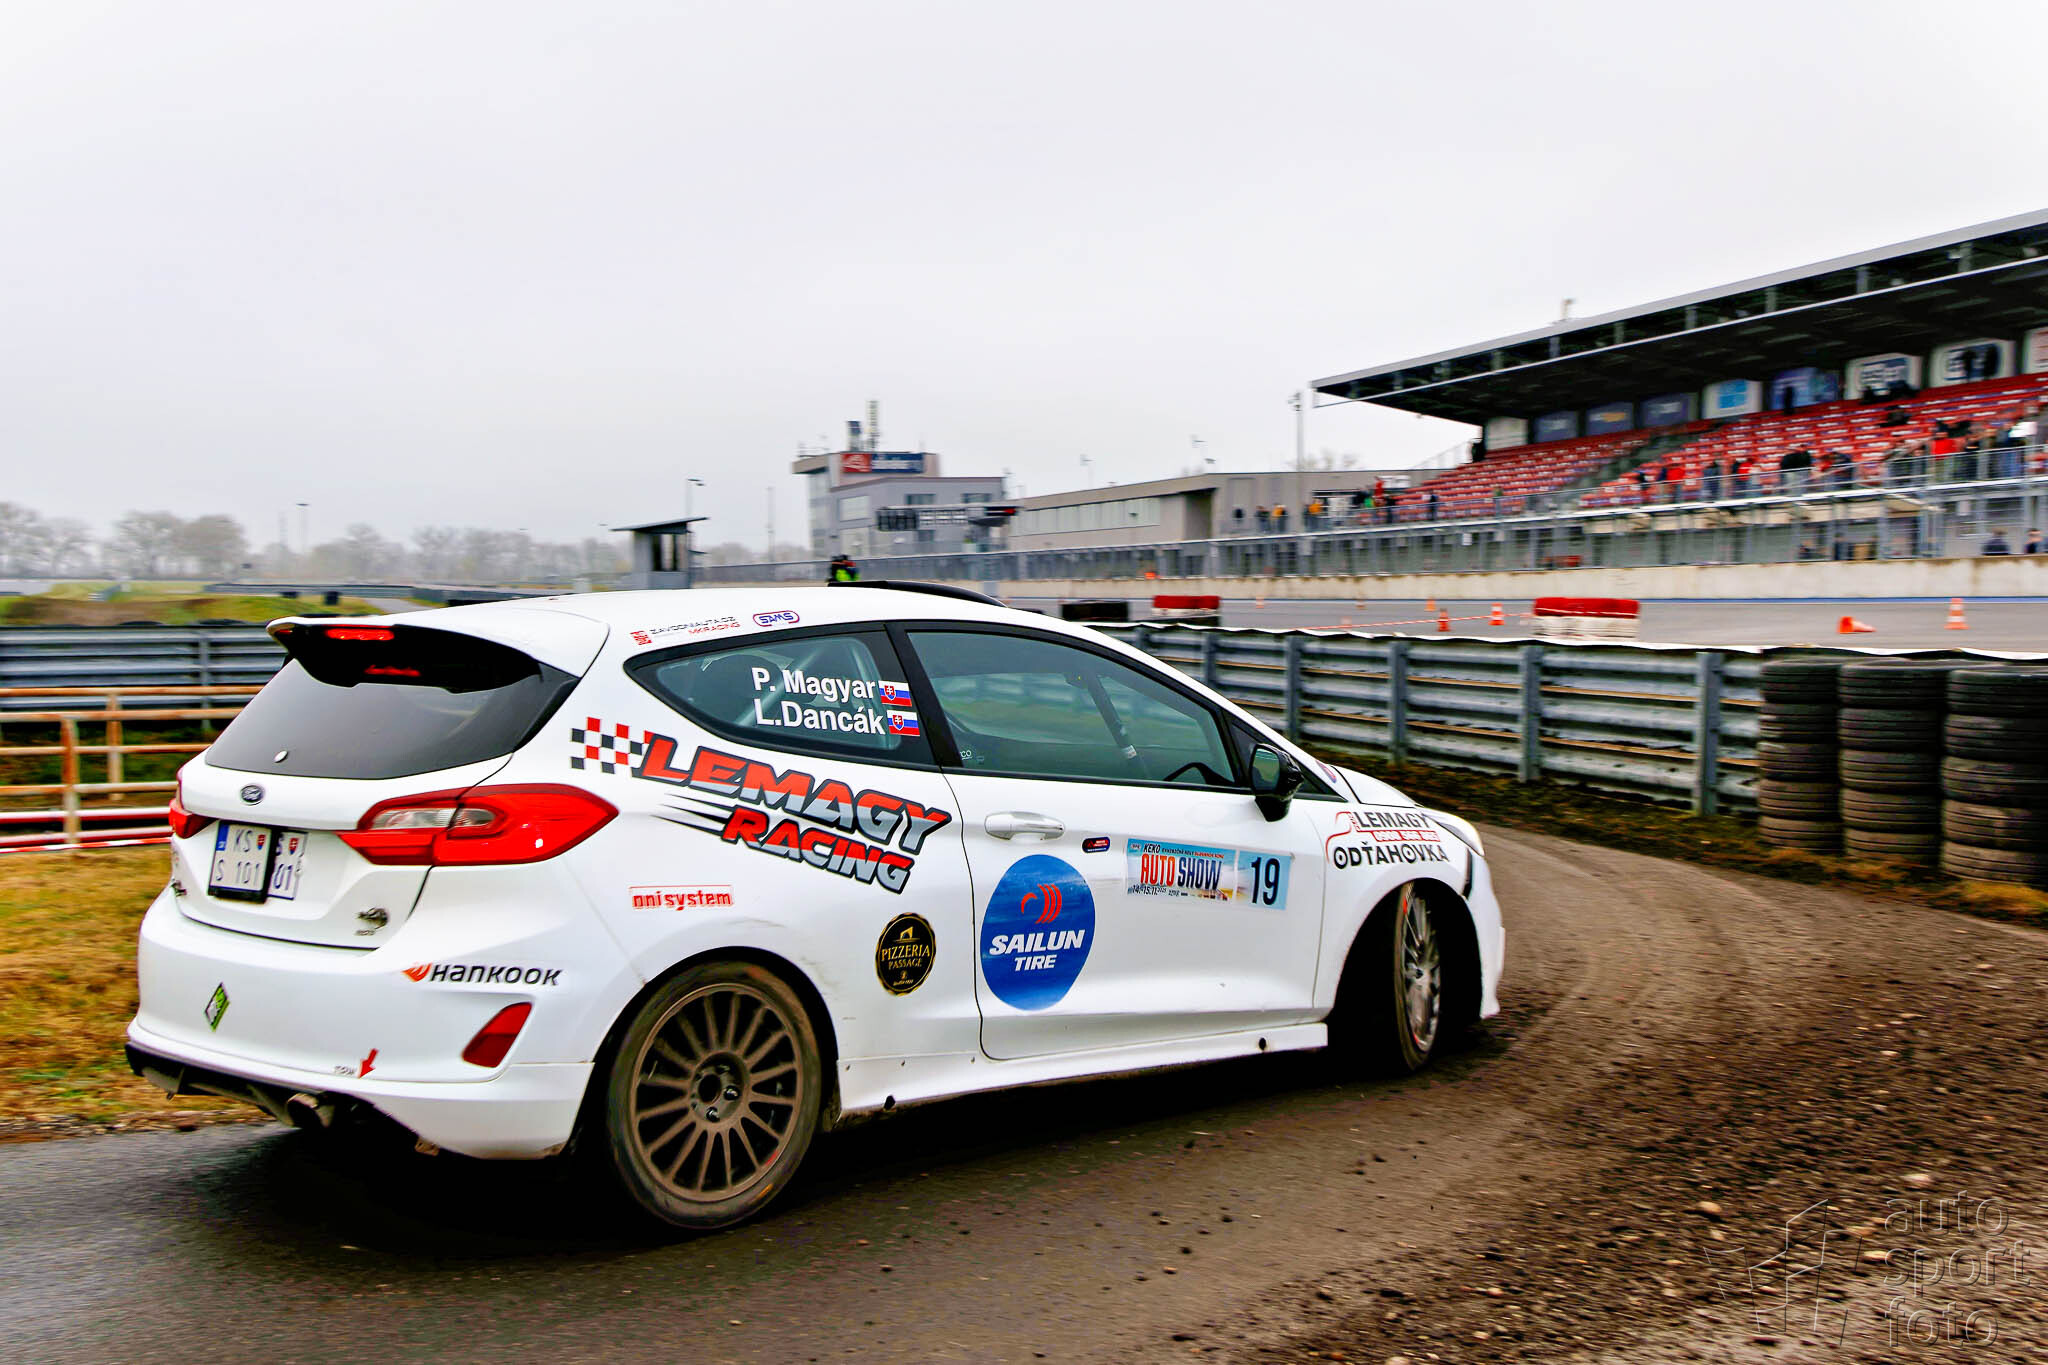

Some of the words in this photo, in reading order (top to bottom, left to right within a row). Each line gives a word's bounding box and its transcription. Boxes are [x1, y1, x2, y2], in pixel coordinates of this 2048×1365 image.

[759, 612, 794, 624] SAMS
[751, 667, 776, 692] P.
[782, 669, 876, 703] Magyar
[754, 698, 886, 736] L.Dancák
[637, 733, 952, 855] LEMAGY
[1352, 811, 1431, 829] LEMAGY
[235, 829, 252, 853] KS
[721, 803, 916, 896] RACING
[1143, 843, 1160, 854] KEKO
[1333, 842, 1450, 870] ODŤAHOVKA
[215, 859, 224, 882] S
[235, 861, 260, 887] 101
[1140, 853, 1176, 887] AUTO
[1177, 856, 1223, 891] SHOW
[1251, 856, 1281, 906] 19
[881, 944, 930, 962] PIZZERIA
[989, 929, 1086, 956] SAILUN
[888, 958, 922, 970] PASSAGE
[1014, 954, 1058, 972] TIRE
